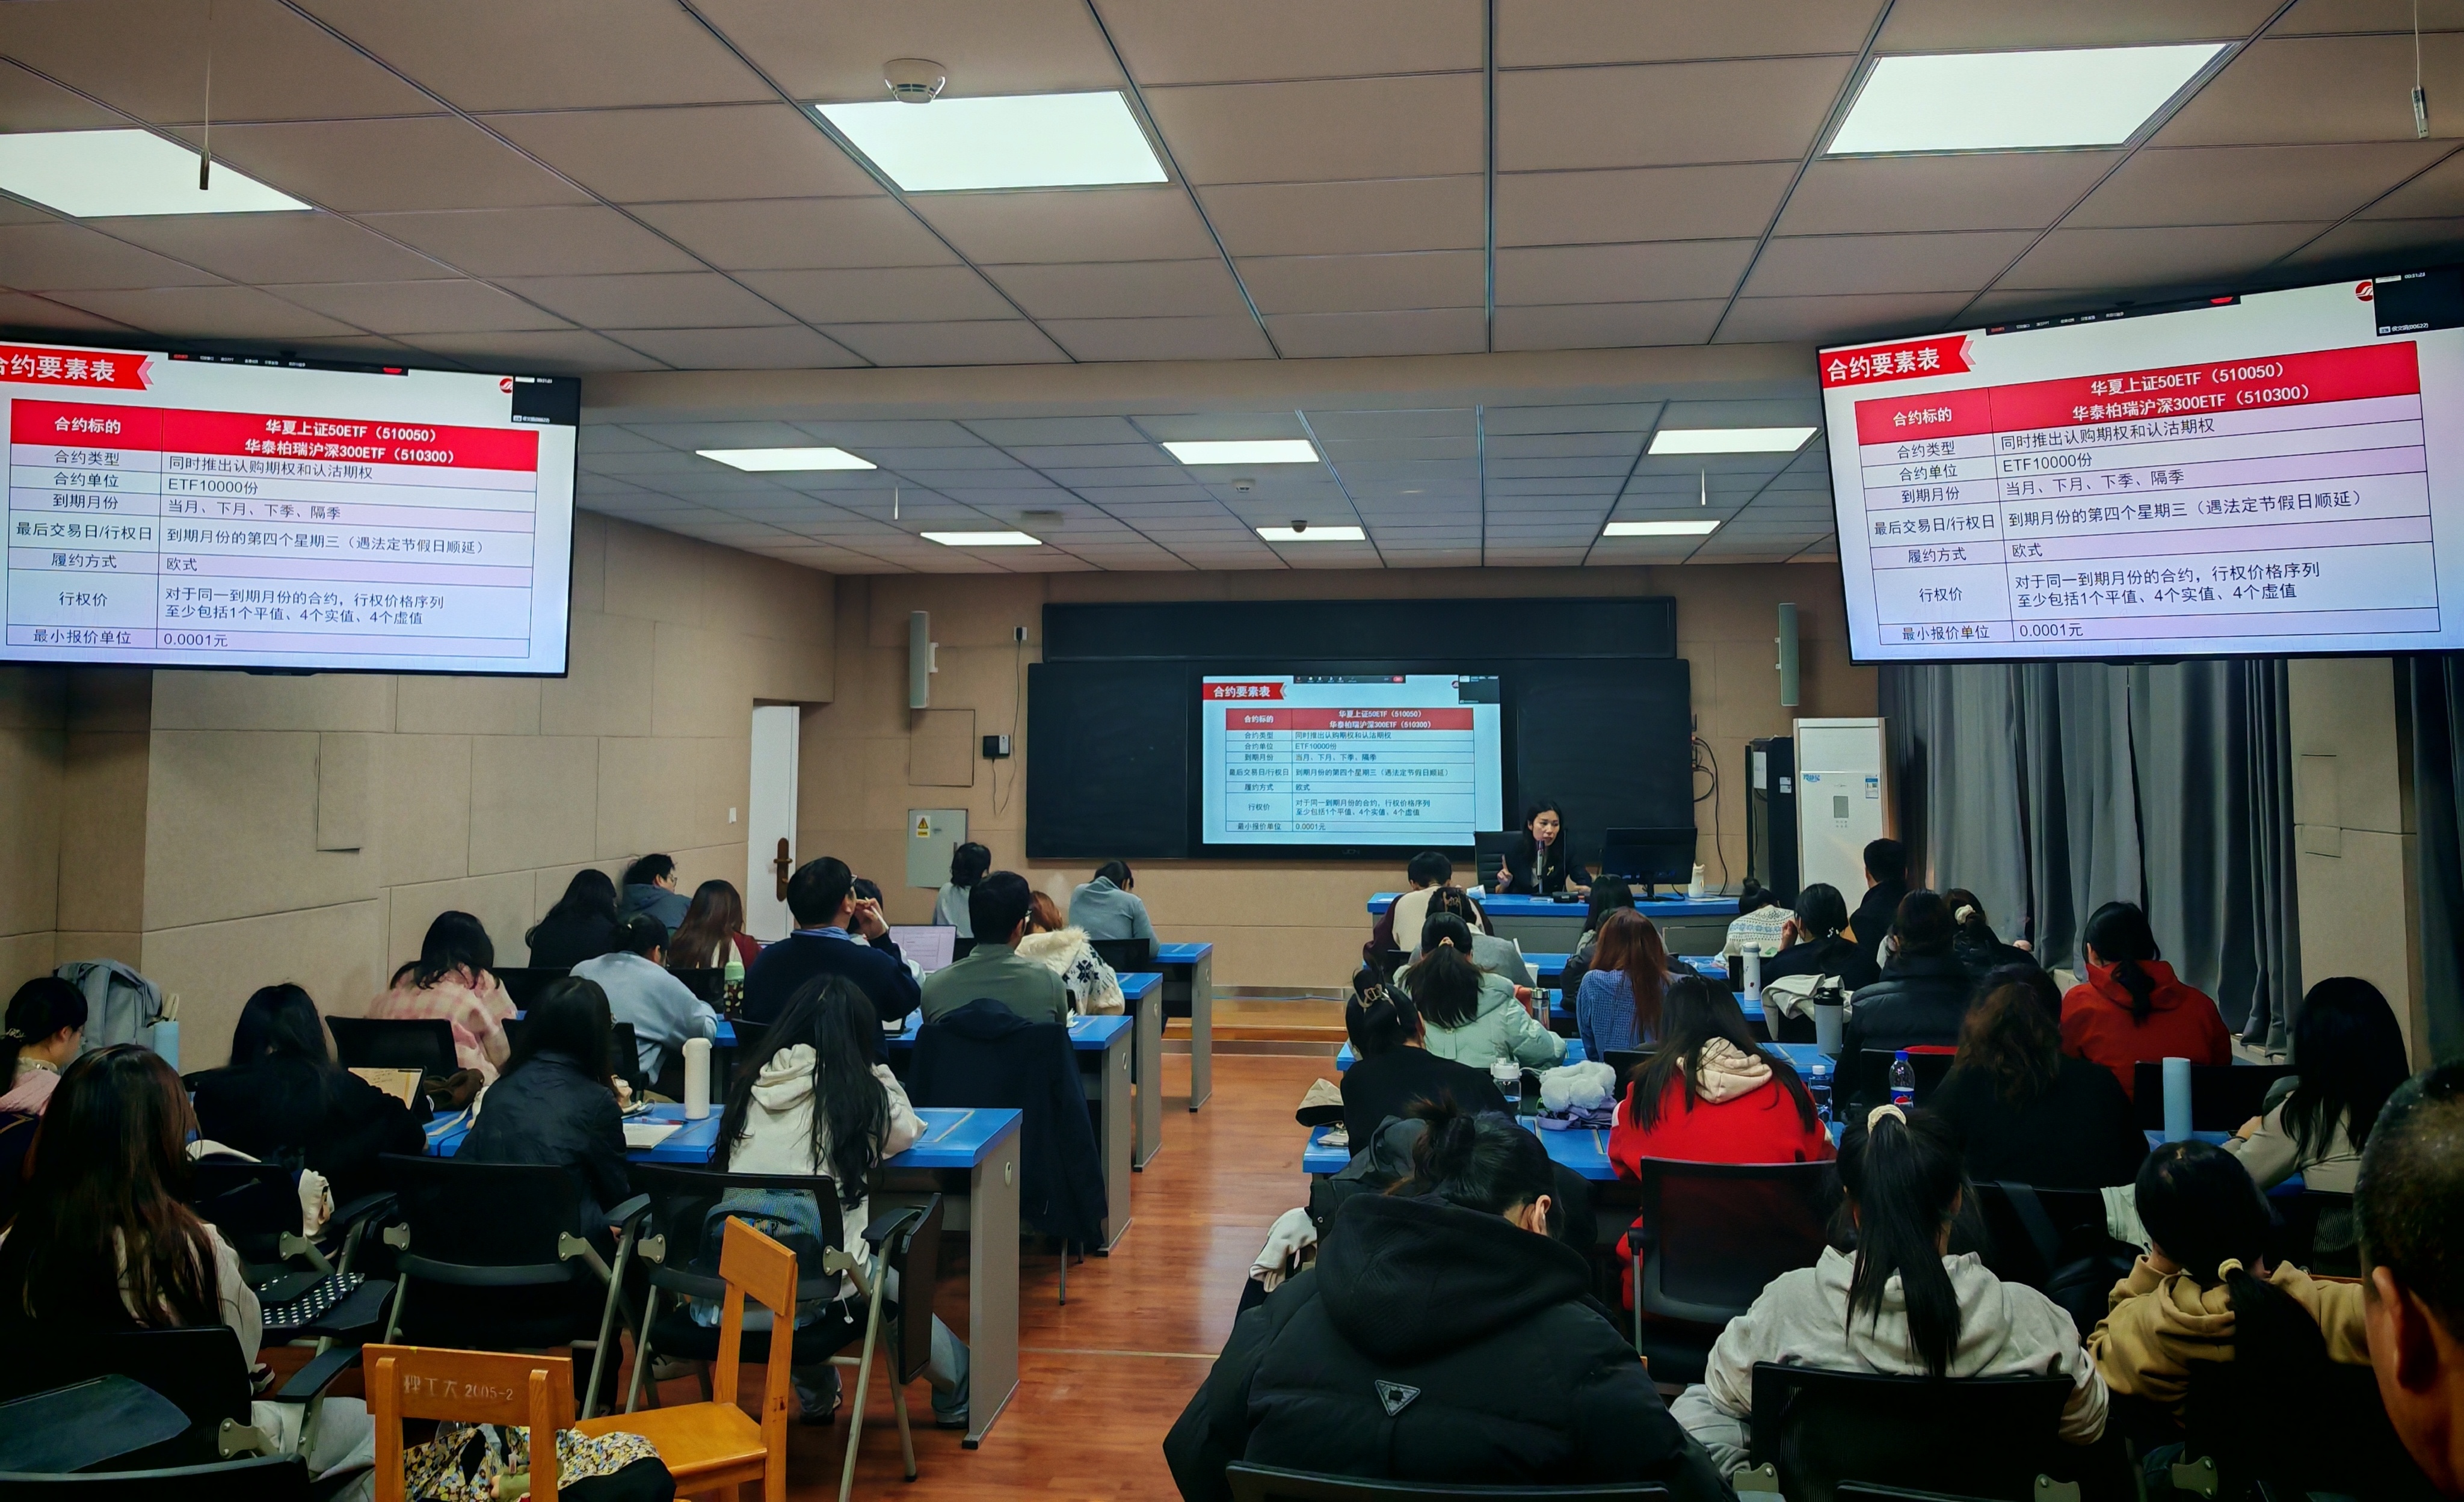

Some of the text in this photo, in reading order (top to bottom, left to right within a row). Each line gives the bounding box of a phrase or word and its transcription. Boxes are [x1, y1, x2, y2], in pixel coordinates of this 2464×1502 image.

[1827, 346, 1940, 382] 合约要素表
[1893, 406, 1953, 427] 合约标的
[54, 416, 121, 435] 合约标的
[54, 450, 120, 466] 合约类型
[1897, 440, 1955, 460] 合约类型
[2003, 452, 2092, 473] ETF10000份
[54, 472, 119, 488] 合约单位
[1899, 463, 1958, 481] 合约单位
[168, 479, 259, 495] ETF10000份
[1901, 485, 1960, 503] 到期月份
[53, 493, 119, 509] 到期月份
[16, 522, 152, 541] 最后交易日/行权日
[1874, 514, 1995, 535] 最后交易日/行权日
[1908, 547, 1967, 563] 履约方式
[2012, 543, 2043, 558] 欧式
[51, 552, 117, 569] 履约方式
[166, 558, 197, 571] 欧式
[59, 591, 108, 608] 行权价
[1919, 586, 1963, 602] 行权价
[33, 629, 131, 645] 最小报价单位
[1902, 624, 1990, 640] 最小报价单位
[2019, 623, 2084, 638] 0.0001元
[164, 633, 229, 647] 0.0001元
[1213, 686, 1270, 697] 合约要素表
[1244, 715, 1274, 723] 合约标的
